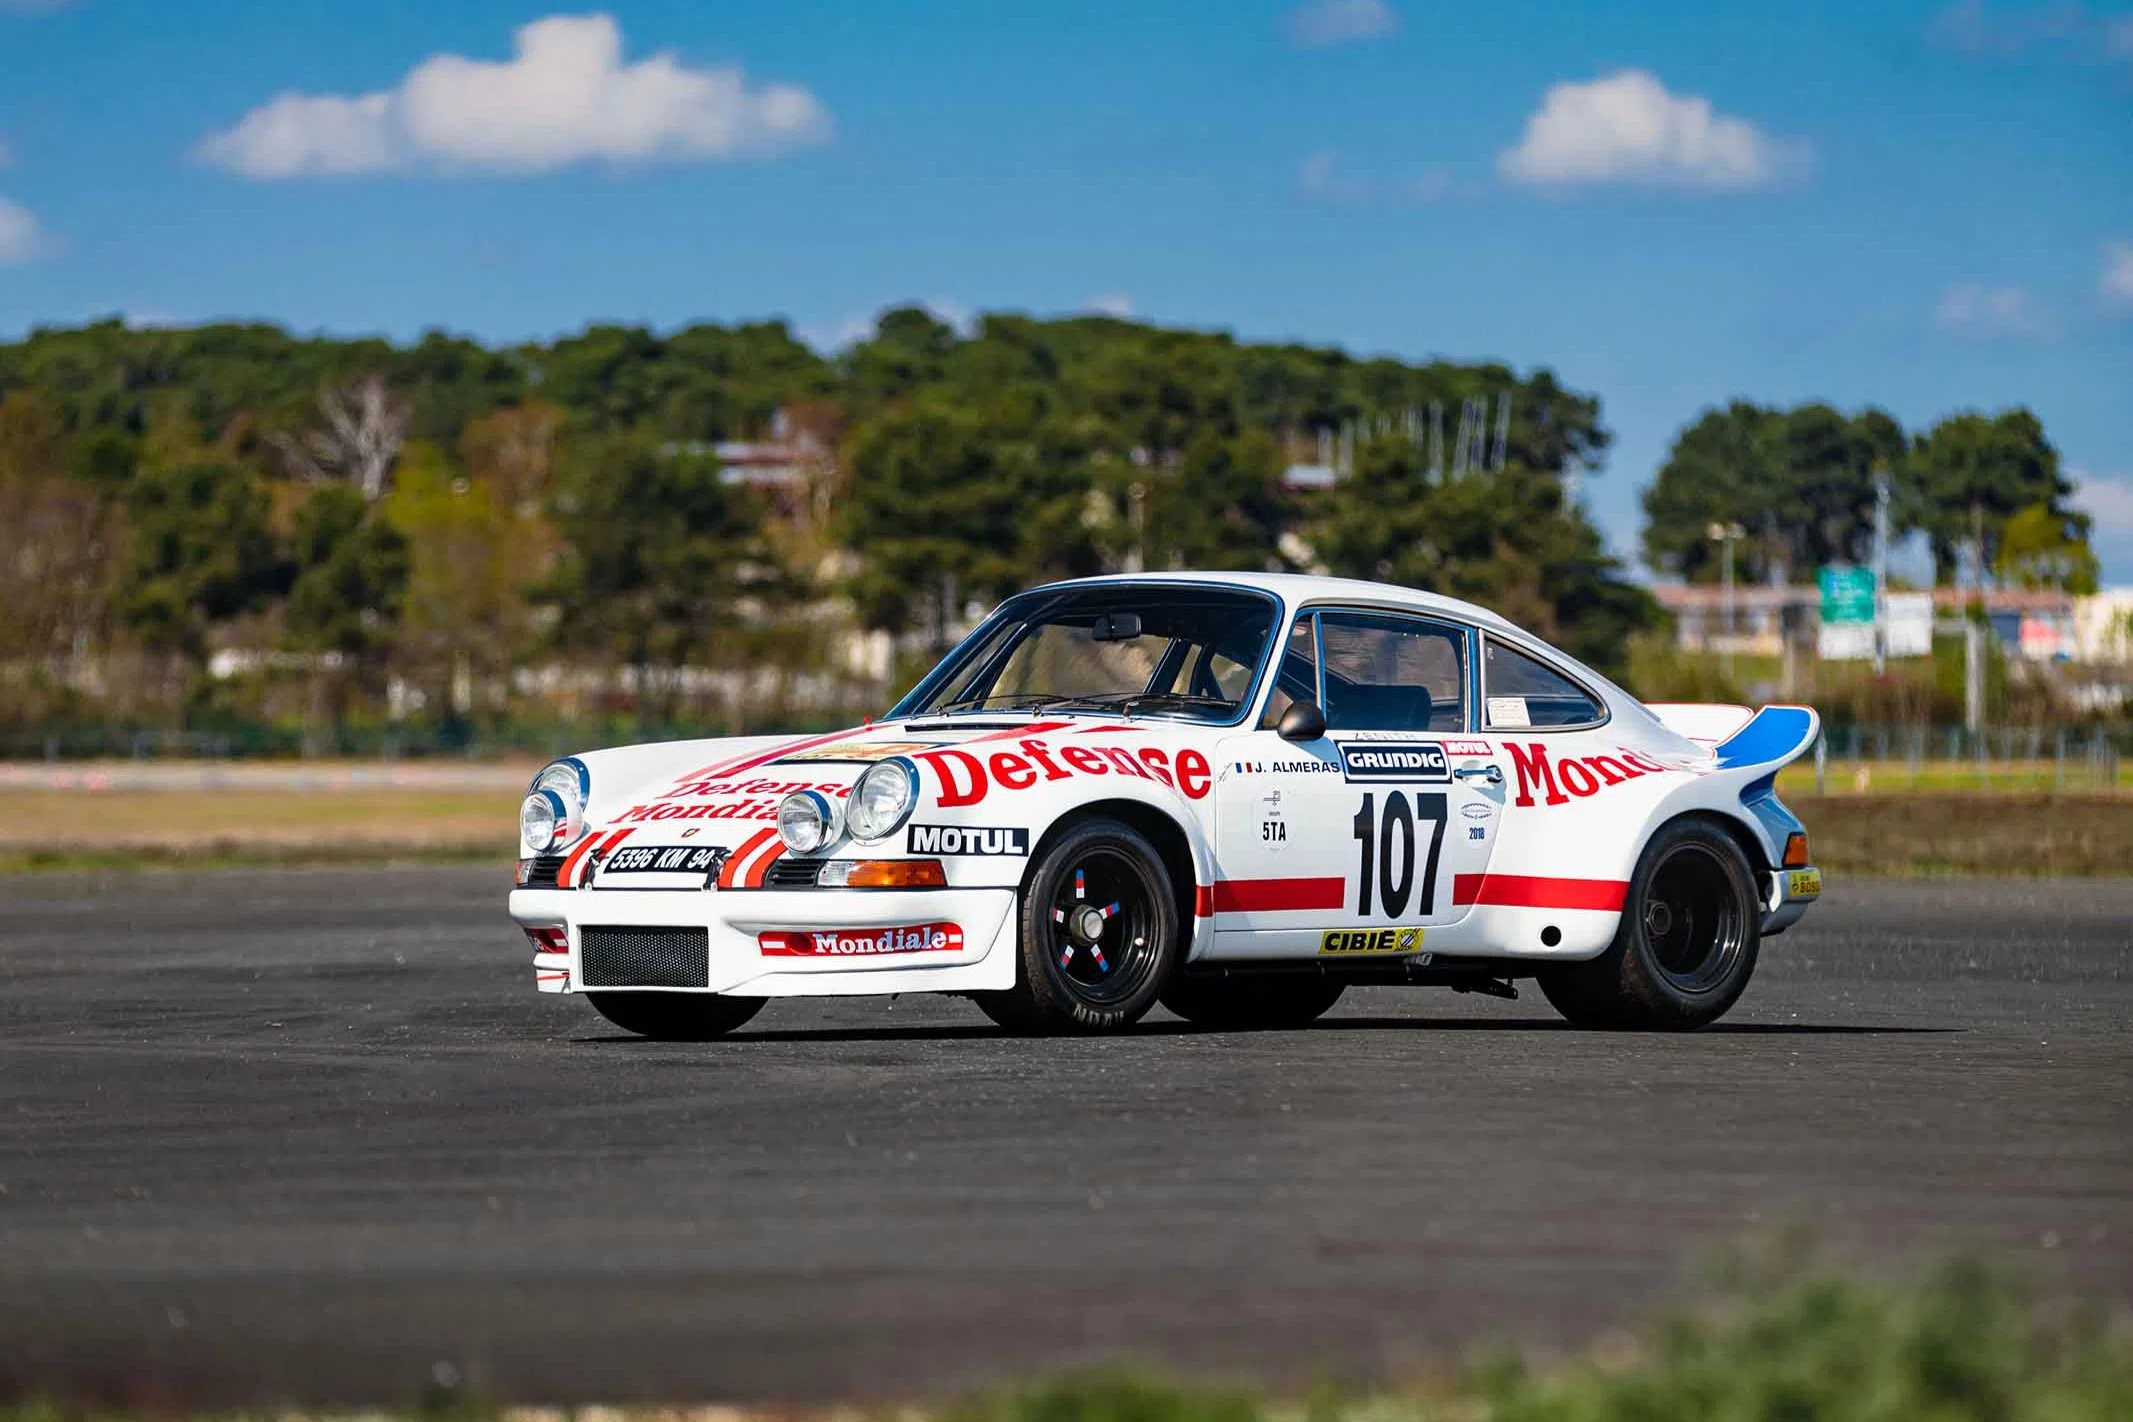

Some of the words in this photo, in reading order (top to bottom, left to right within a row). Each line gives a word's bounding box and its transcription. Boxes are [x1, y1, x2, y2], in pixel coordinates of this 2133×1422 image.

[1255, 761, 1267, 773] J.
[1272, 761, 1340, 773] ALMERAS
[1347, 752, 1444, 768] GRUNDIG
[912, 739, 1212, 808] Defense
[607, 797, 778, 824] Mondia
[912, 827, 1023, 854] MOTUL
[1262, 821, 1287, 841] 5TA
[1469, 827, 1485, 840] 2018
[610, 848, 659, 869] 5396
[654, 848, 692, 869] KM
[687, 848, 716, 869] 94
[1353, 790, 1448, 919] 107
[812, 927, 947, 954] Mondiale
